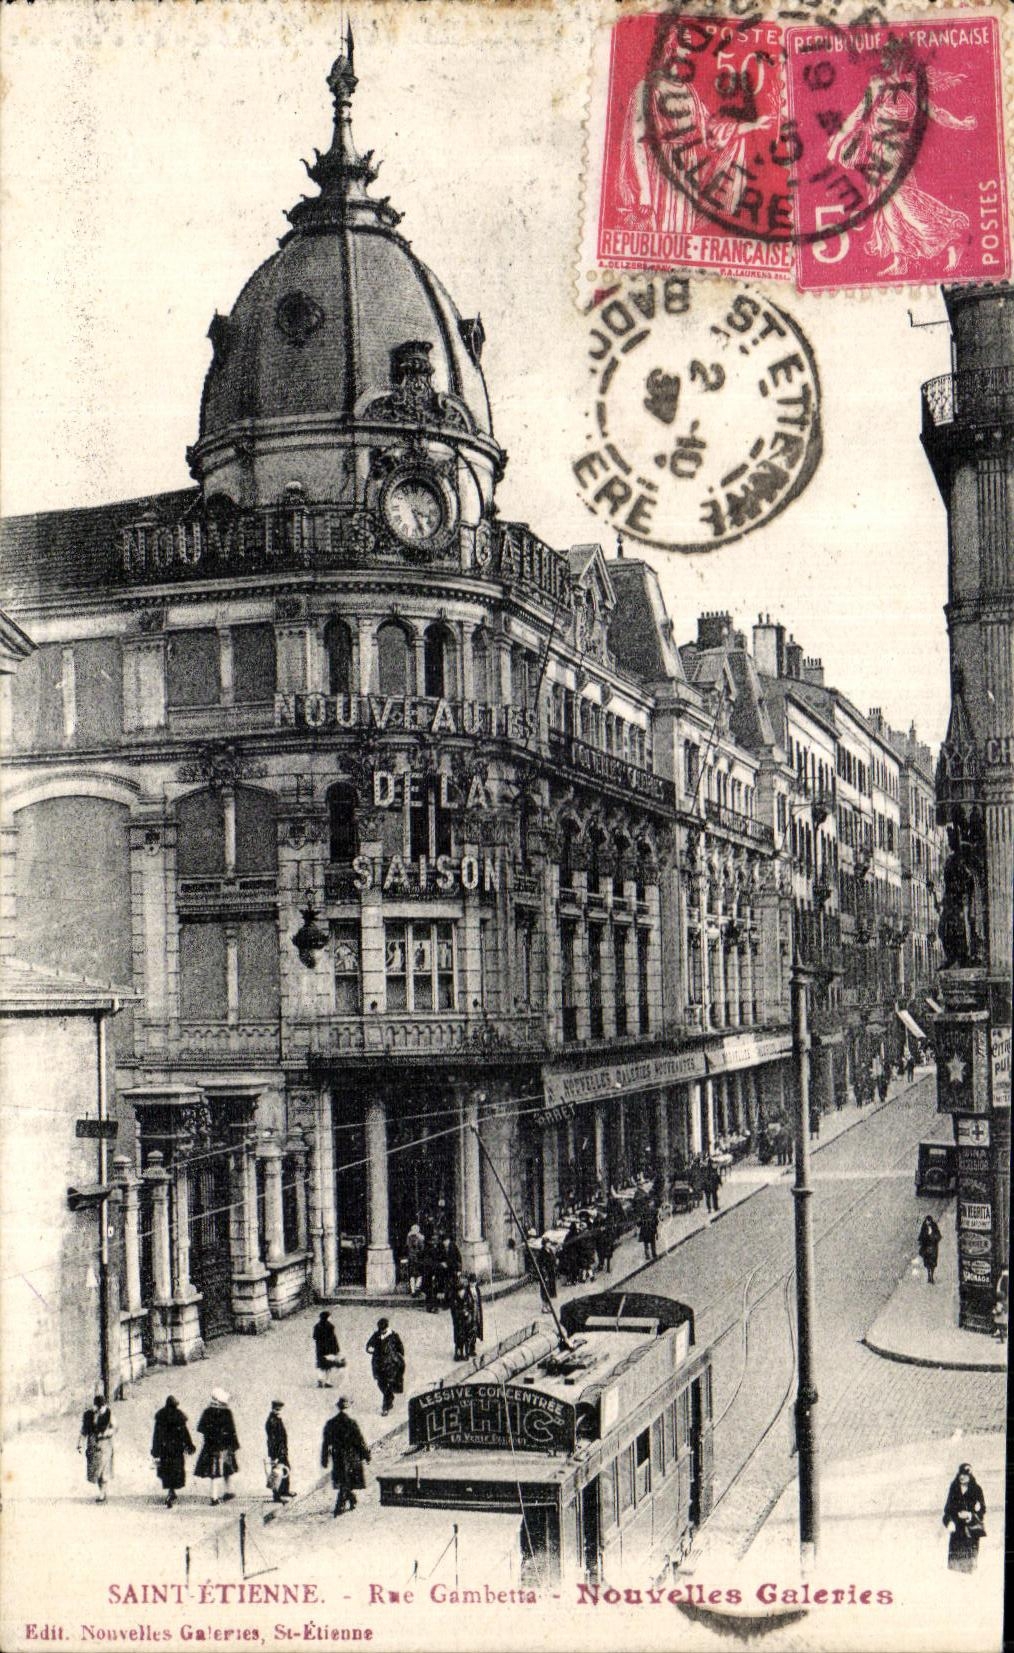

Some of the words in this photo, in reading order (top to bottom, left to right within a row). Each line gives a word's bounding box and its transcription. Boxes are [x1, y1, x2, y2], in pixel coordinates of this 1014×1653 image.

[812, 205, 850, 264] 5
[978, 180, 1000, 266] POSTES
[373, 770, 423, 808] DE
[440, 773, 488, 809] LA
[352, 854, 502, 892] SAISON
[418, 1386, 473, 1409] LESSIVE
